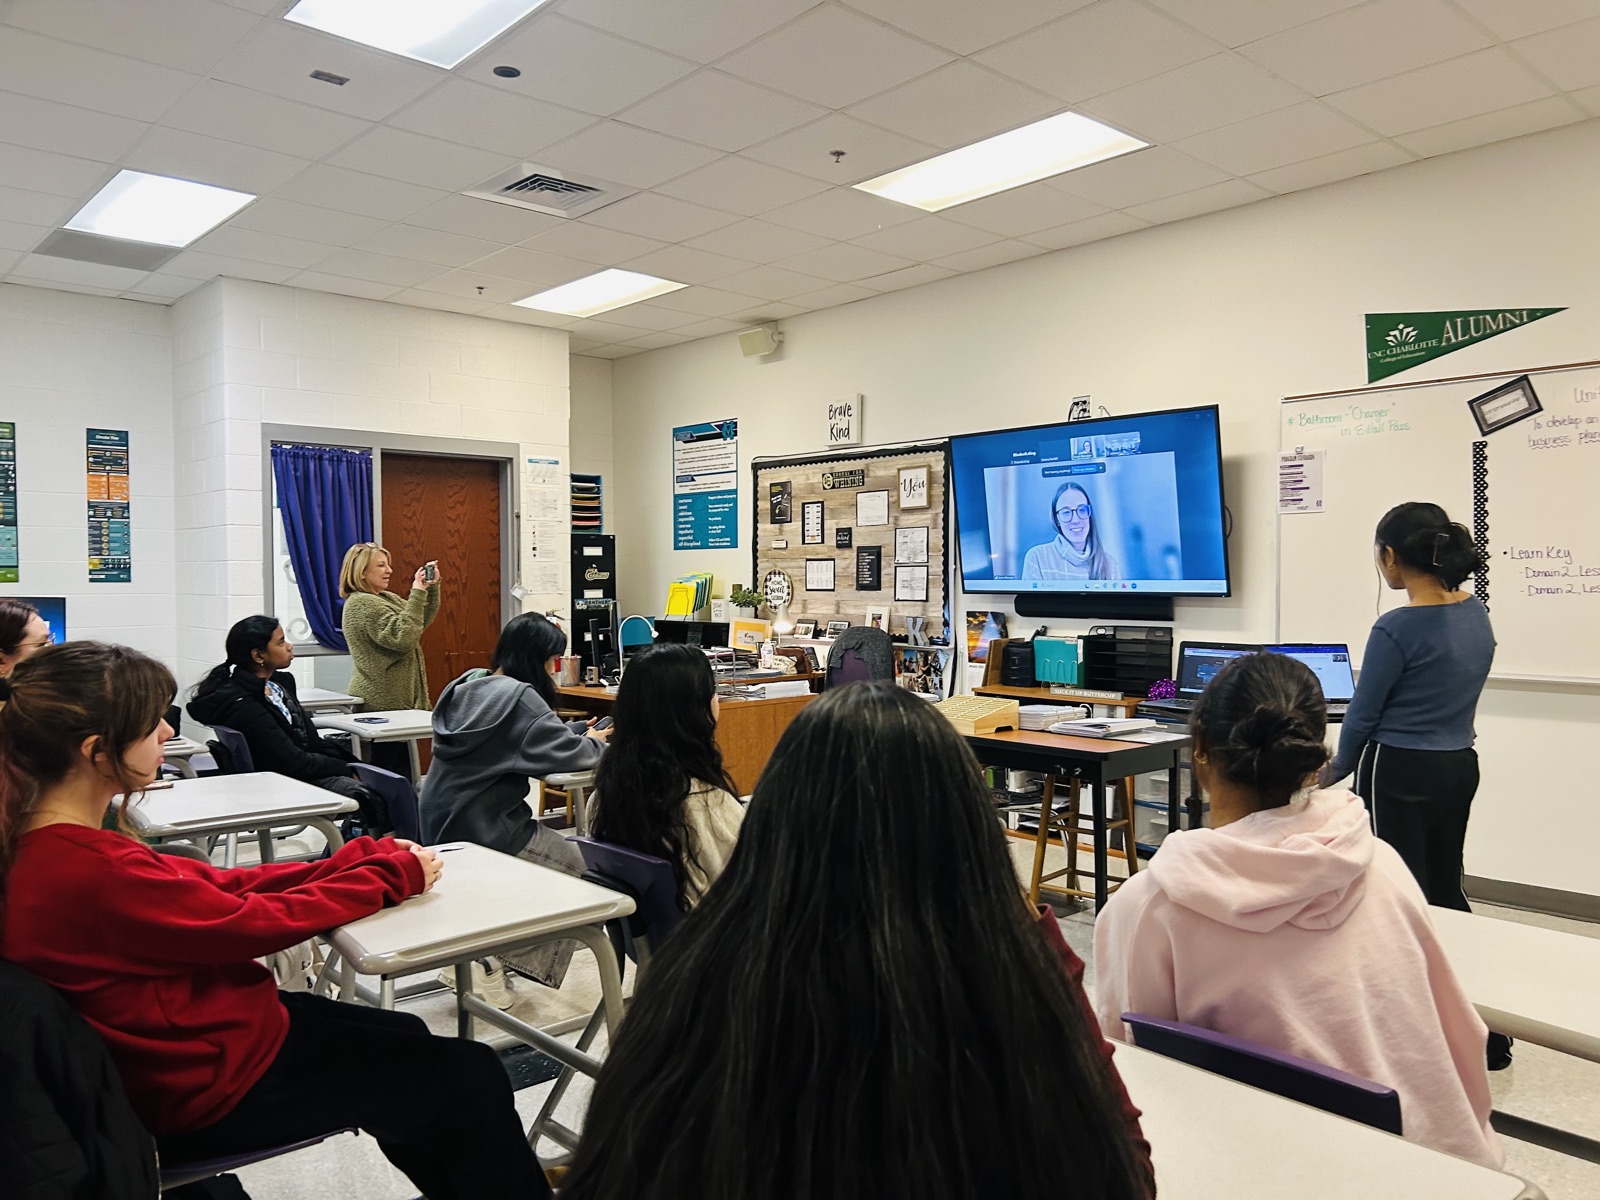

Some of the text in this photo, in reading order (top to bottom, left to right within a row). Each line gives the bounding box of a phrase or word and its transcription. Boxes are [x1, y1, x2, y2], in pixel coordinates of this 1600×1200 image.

[1440, 310, 1530, 347] ALUMNI
[1367, 338, 1440, 360] UNC CHARLOTTE
[1574, 386, 1600, 403] Uni
[829, 403, 852, 420] Brave
[1299, 413, 1342, 427] Bathroom
[1546, 415, 1582, 429] develop
[830, 419, 850, 441] Kind
[1340, 425, 1351, 436] in
[1388, 420, 1411, 432] Pass
[1528, 435, 1572, 448] business
[833, 475, 863, 488] WHINING
[903, 478, 926, 498] You
[1525, 566, 1560, 578] Domain
[1527, 584, 1563, 597] Domain
[1083, 691, 1116, 699] BUTTERCUP
